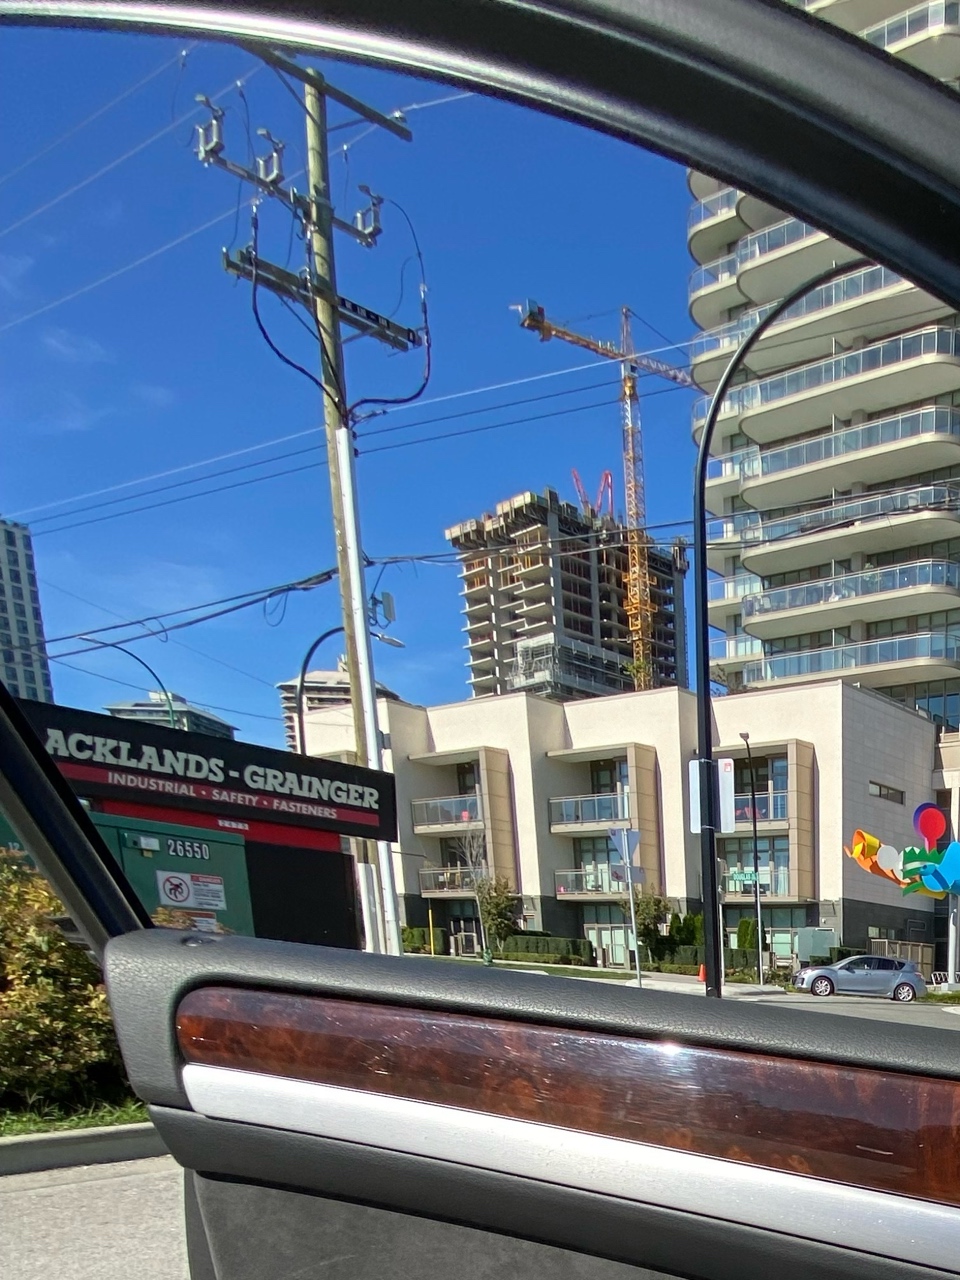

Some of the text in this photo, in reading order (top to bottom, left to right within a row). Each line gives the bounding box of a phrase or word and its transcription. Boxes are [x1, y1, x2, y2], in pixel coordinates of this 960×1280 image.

[45, 728, 224, 782] ACKLANDS
[244, 765, 379, 809] GRAINGER
[108, 771, 337, 819] INDUSTRIAL SAFETY FASTENERS
[168, 839, 210, 860] 26550
